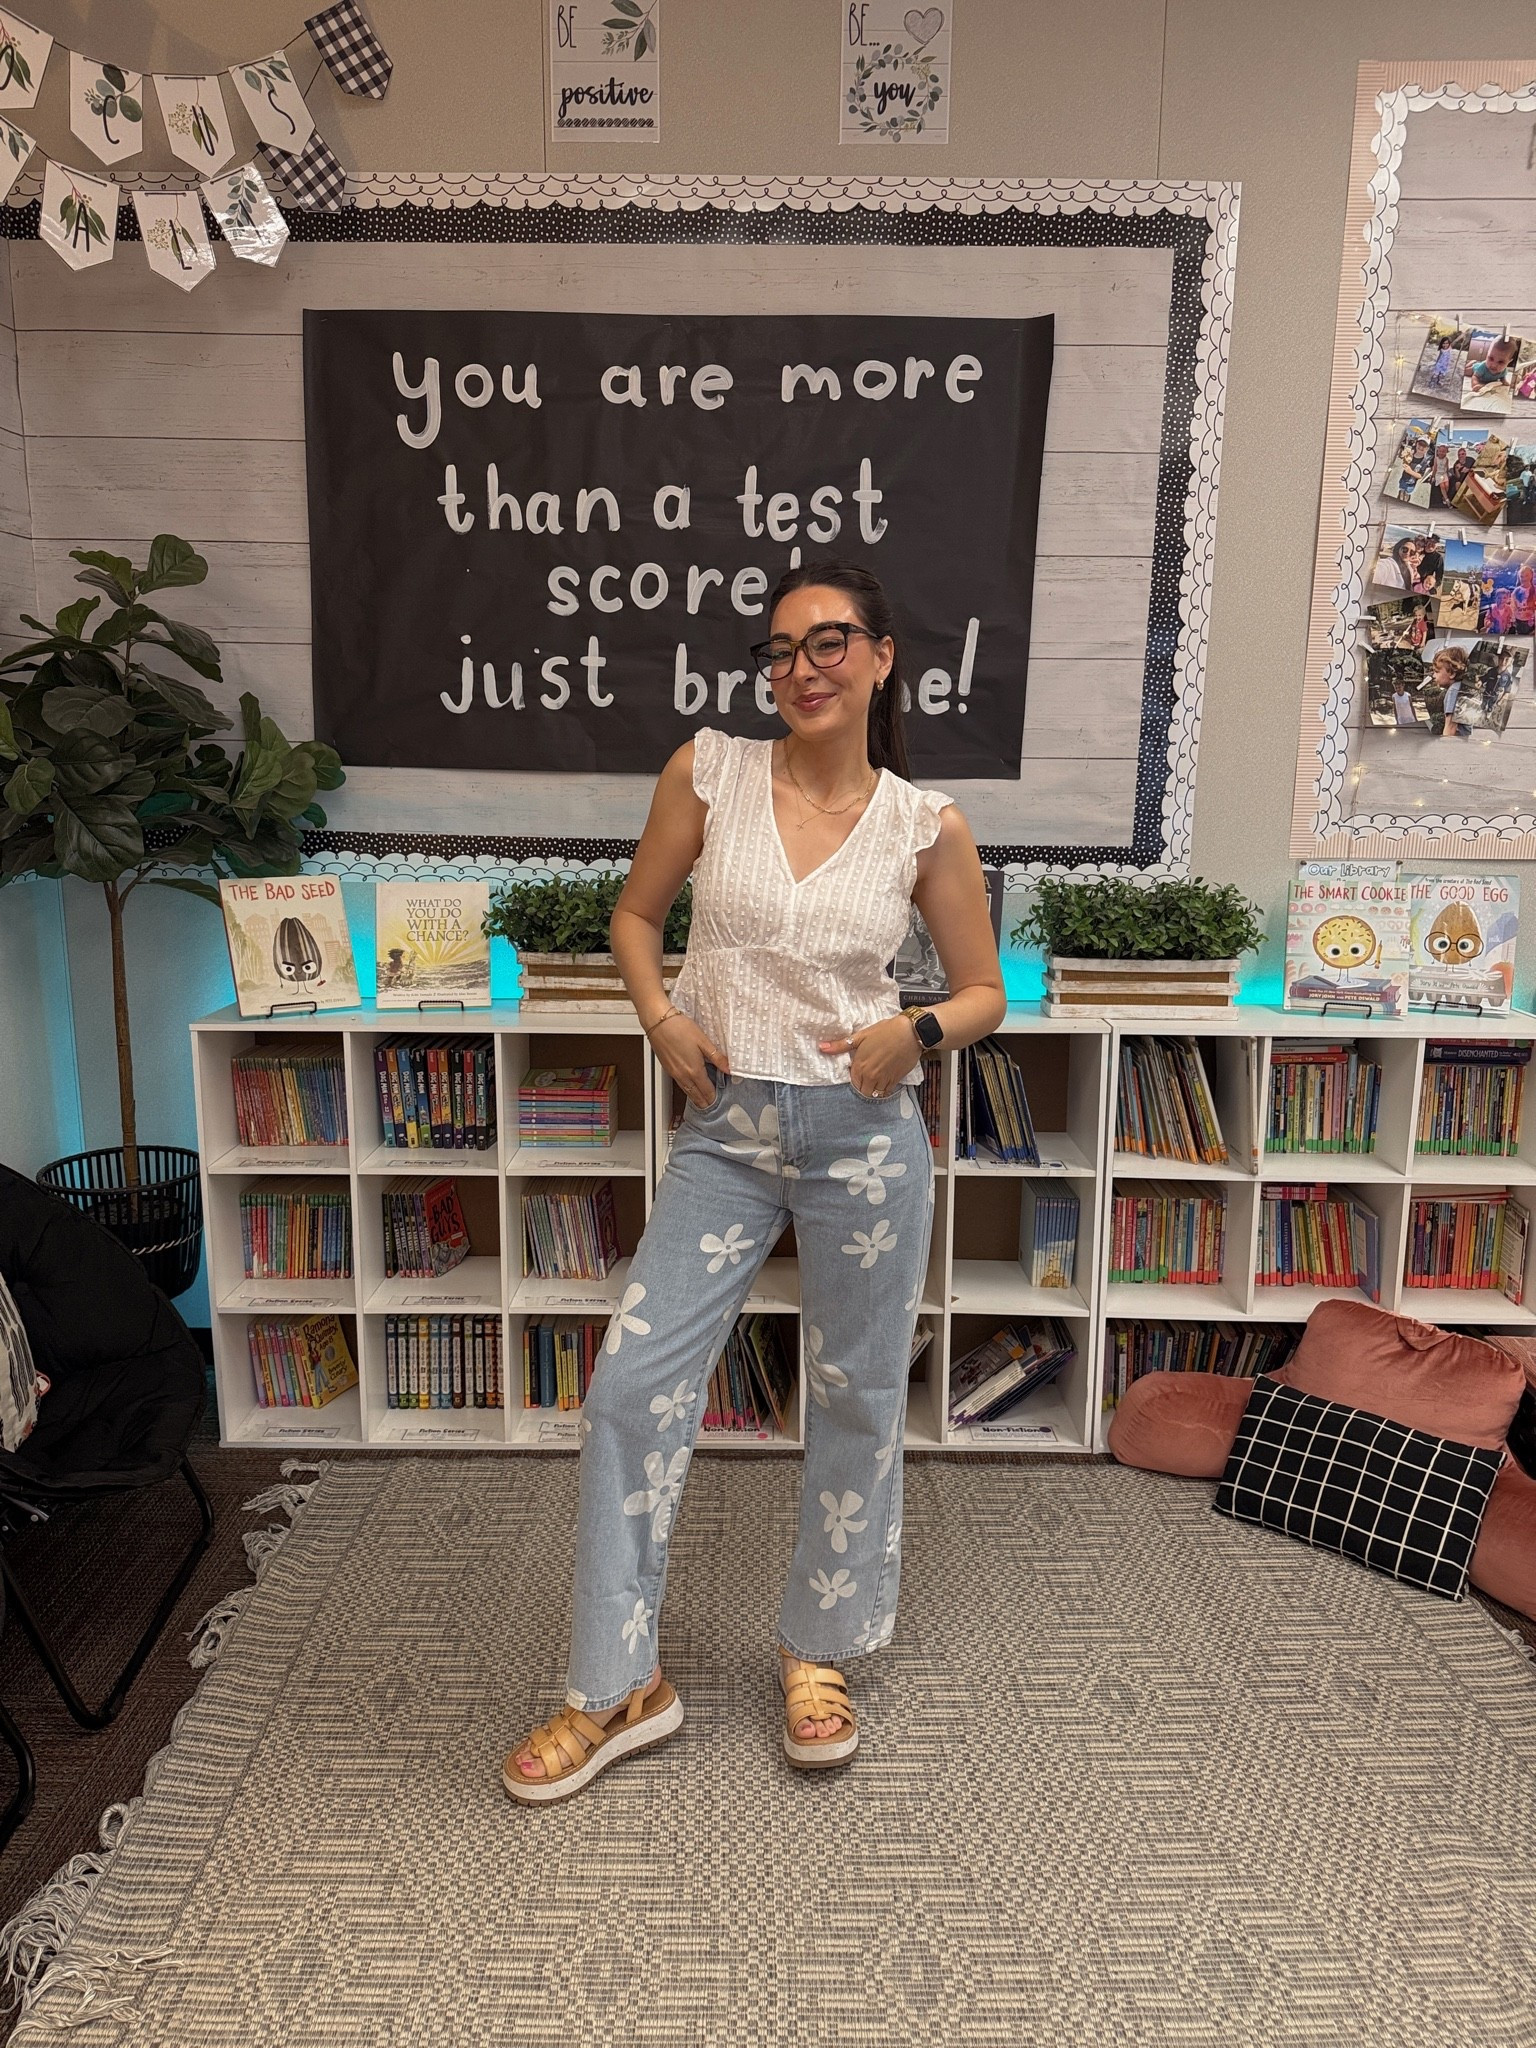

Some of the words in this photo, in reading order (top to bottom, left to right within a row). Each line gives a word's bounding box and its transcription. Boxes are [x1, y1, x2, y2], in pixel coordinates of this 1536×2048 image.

[557, 4, 577, 48] BE
[558, 76, 654, 118] positive
[874, 79, 916, 115] you
[393, 351, 542, 449] you
[601, 363, 733, 411] are
[781, 353, 983, 402] more
[437, 463, 621, 535] than
[653, 484, 691, 530] a
[736, 457, 889, 545] test
[546, 547, 802, 617] score
[440, 634, 614, 715] just
[1308, 863, 1337, 876] Our
[229, 884, 259, 901] THE
[265, 882, 295, 901] BAD
[301, 880, 336, 901] SEED
[1294, 885, 1314, 899] THE
[1318, 885, 1357, 900] SMART
[1361, 886, 1407, 901] COOKIE
[1411, 884, 1432, 899] THE
[1440, 885, 1475, 901] GOOD
[1483, 887, 1508, 902] EGG
[406, 898, 441, 908] WHAT
[444, 898, 462, 908] DO
[406, 908, 437, 919] YOU
[440, 908, 462, 919] DO
[407, 919, 448, 930] WITH
[450, 919, 462, 930] A
[407, 930, 469, 942] CHANCE?
[1458, 1050, 1499, 1058] DISENCHANTED
[432, 1195, 455, 1224] BAD
[430, 1212, 460, 1243] GUYS
[303, 1315, 334, 1338] Ramona
